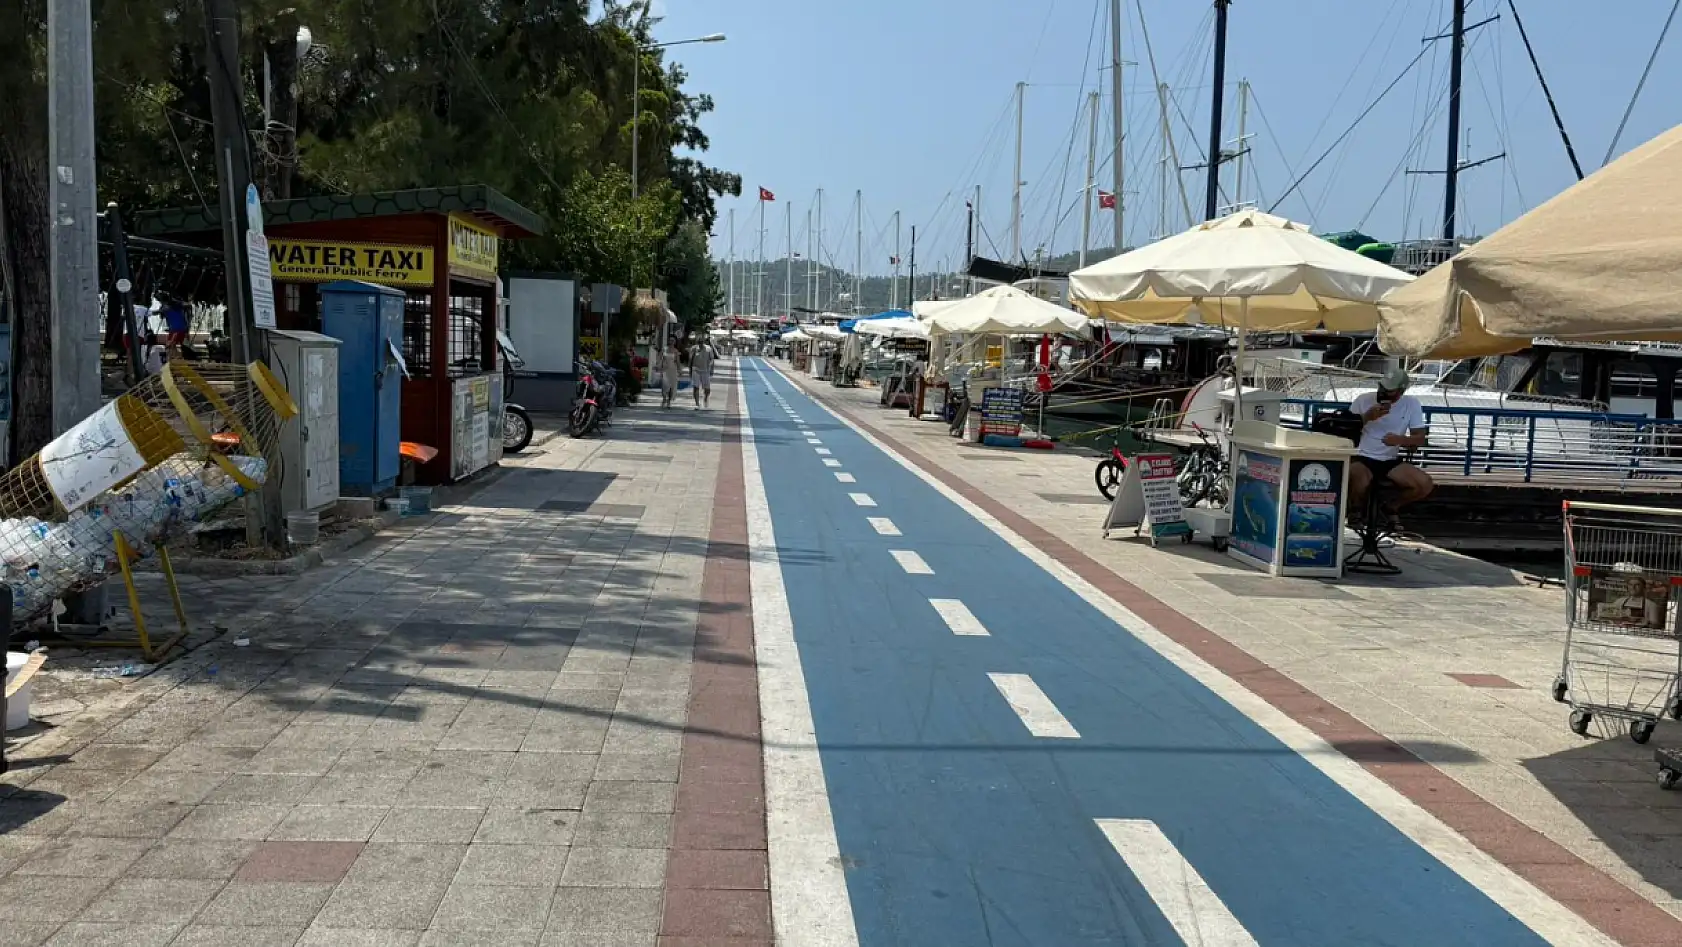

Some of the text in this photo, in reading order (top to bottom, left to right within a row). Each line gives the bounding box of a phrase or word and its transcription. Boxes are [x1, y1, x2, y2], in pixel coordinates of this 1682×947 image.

[270, 243, 356, 266] WATER
[363, 249, 424, 270] TAXI
[278, 264, 409, 281] General Public Ferry
